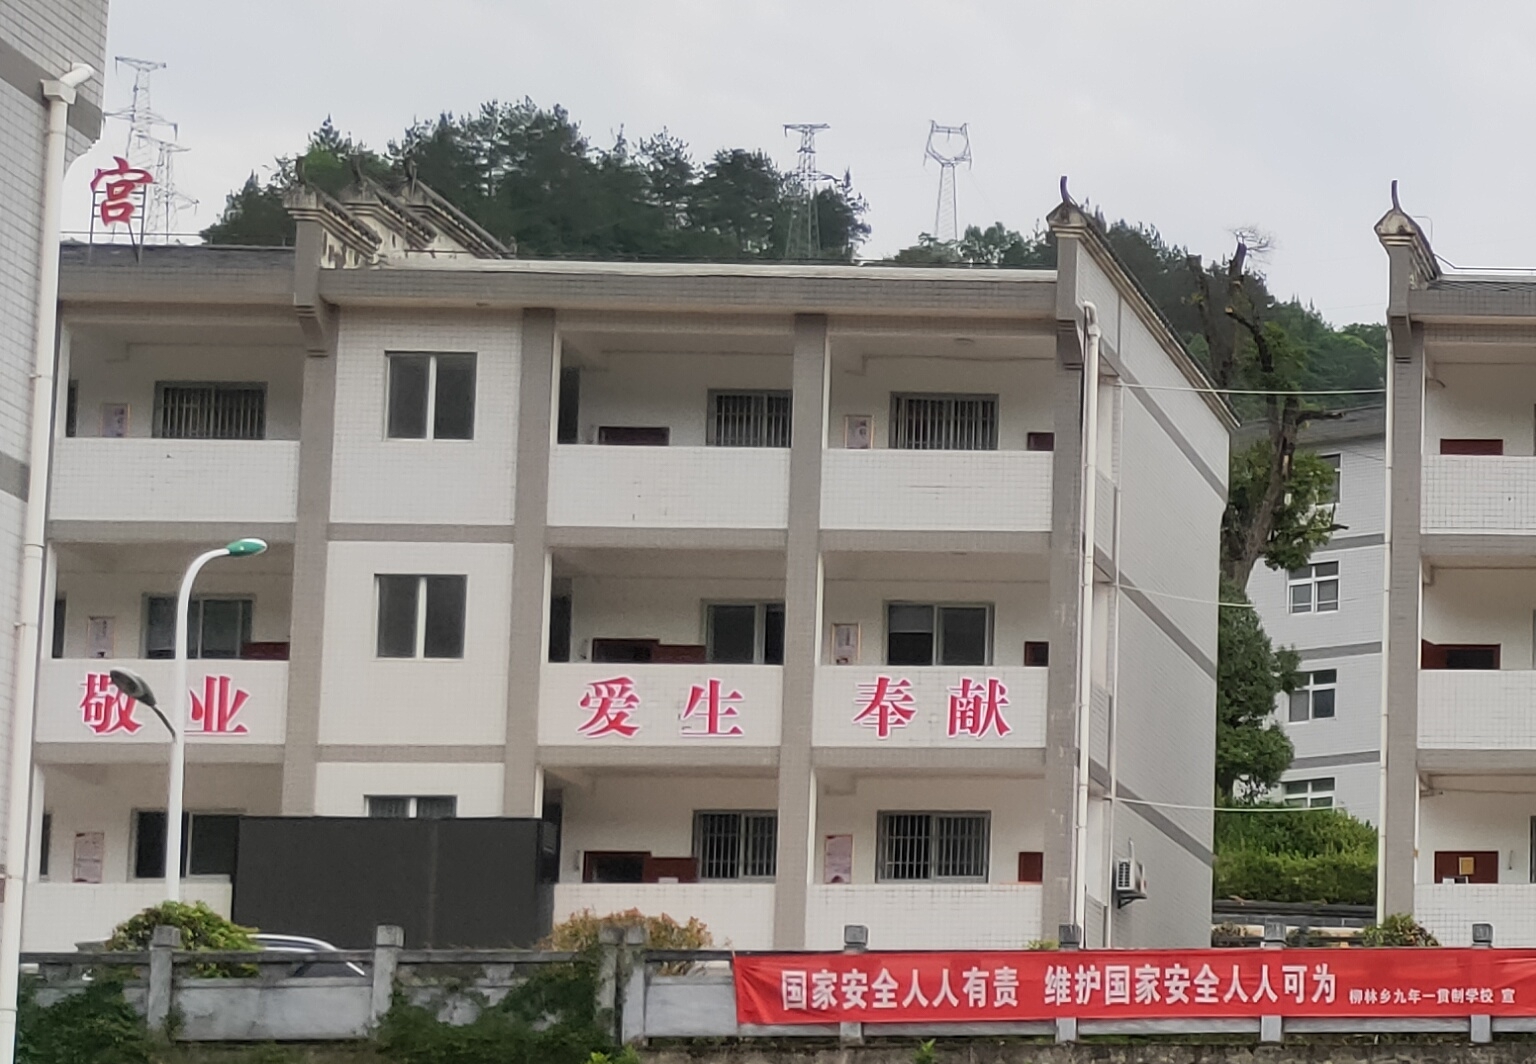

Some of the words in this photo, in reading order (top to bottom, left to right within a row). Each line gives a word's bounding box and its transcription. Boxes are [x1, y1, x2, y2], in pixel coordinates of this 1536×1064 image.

[90, 156, 154, 227] 宫
[80, 672, 249, 734] 敬业
[579, 676, 742, 738] 爱生
[855, 676, 1010, 738] 奉献
[781, 965, 1020, 1011] 国家安全人人有责
[1044, 963, 1337, 1008] 维护国家安全人人可为
